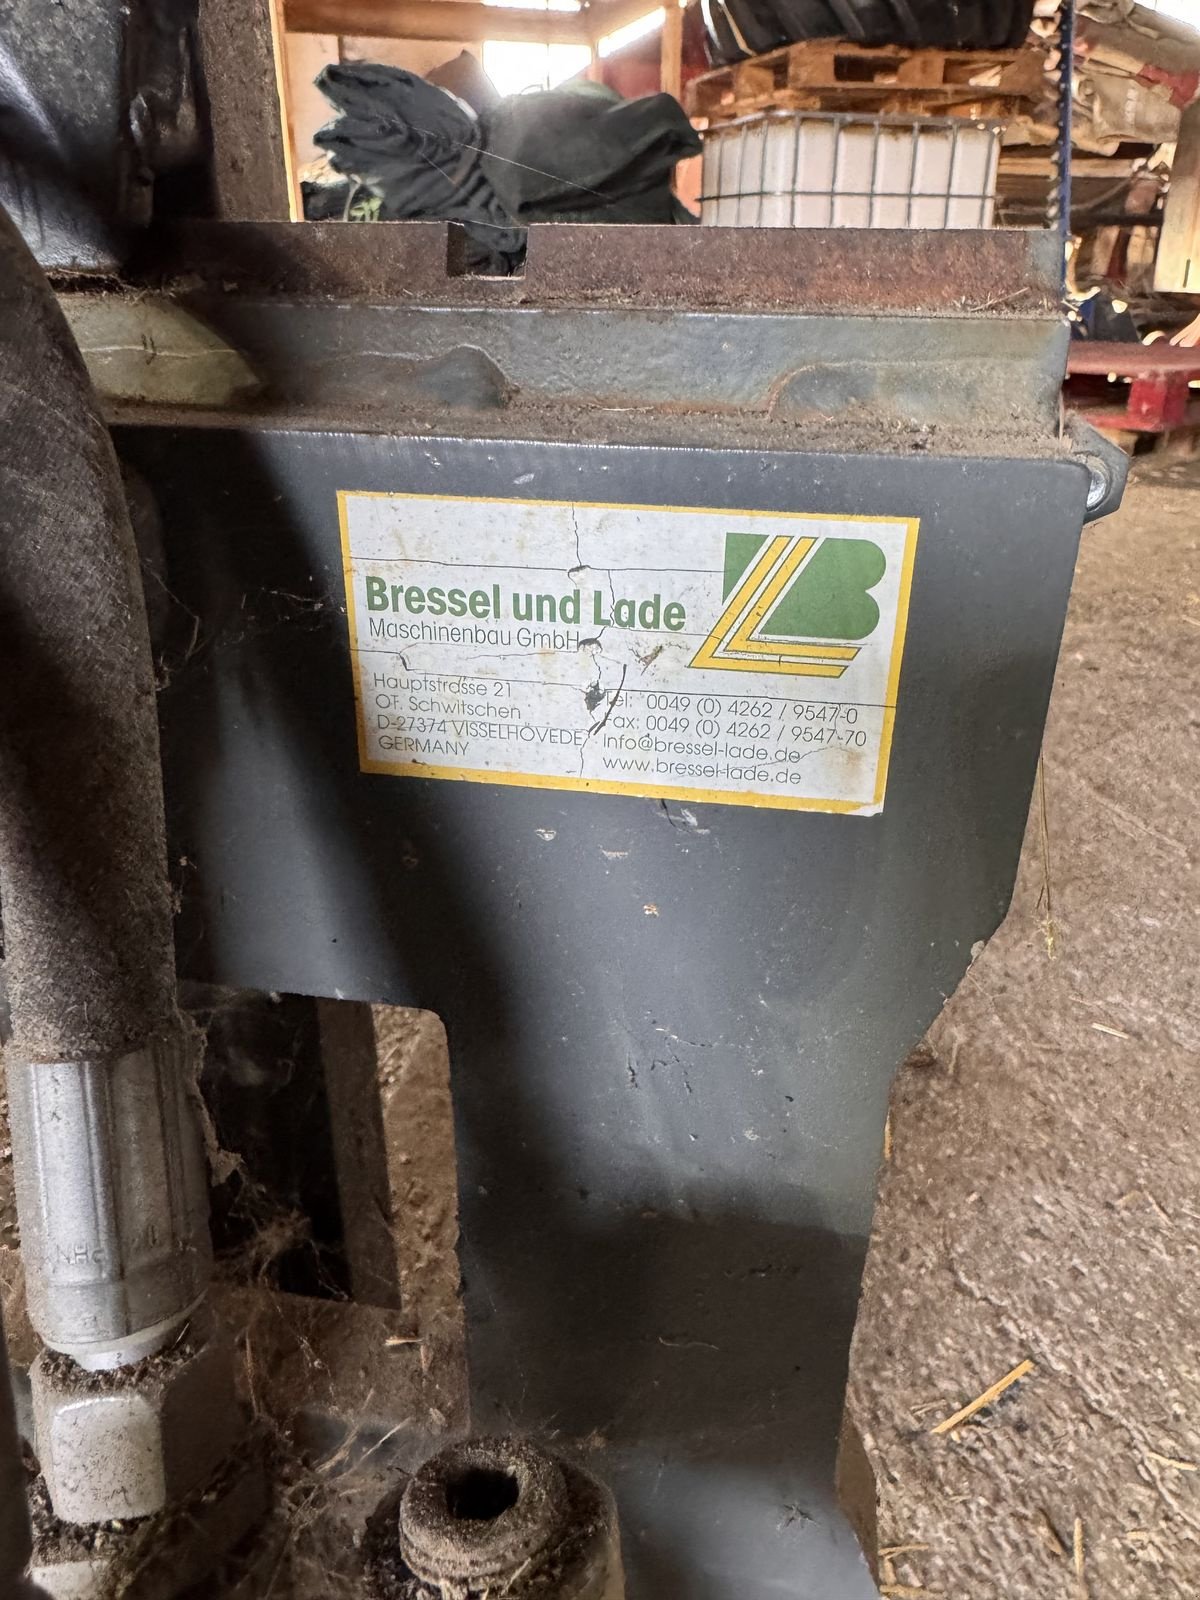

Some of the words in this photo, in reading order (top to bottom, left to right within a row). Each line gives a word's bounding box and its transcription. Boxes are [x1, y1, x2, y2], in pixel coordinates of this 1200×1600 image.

[365, 575, 501, 620] Bressel
[512, 589, 581, 625] und
[593, 590, 687, 632] Lade
[369, 617, 511, 646] Maschinenbau
[516, 627, 580, 651] GmbH
[373, 672, 488, 696] Hauptstrasse
[493, 682, 512, 698] 21
[409, 695, 521, 720] Schwitschen
[646, 693, 691, 712] 0049
[696, 698, 722, 718] (0)
[727, 700, 773, 719] 4262
[778, 703, 787, 720] /
[793, 704, 859, 725] 9547-0
[377, 714, 447, 735] D-27374
[645, 715, 690, 734] 0049
[695, 719, 721, 739] (0)
[725, 721, 771, 740] 4262
[776, 724, 786, 742] /
[791, 725, 868, 747] 9547-70
[378, 735, 470, 756] GERMANY
[602, 757, 802, 785] www.bressel-lade.de
